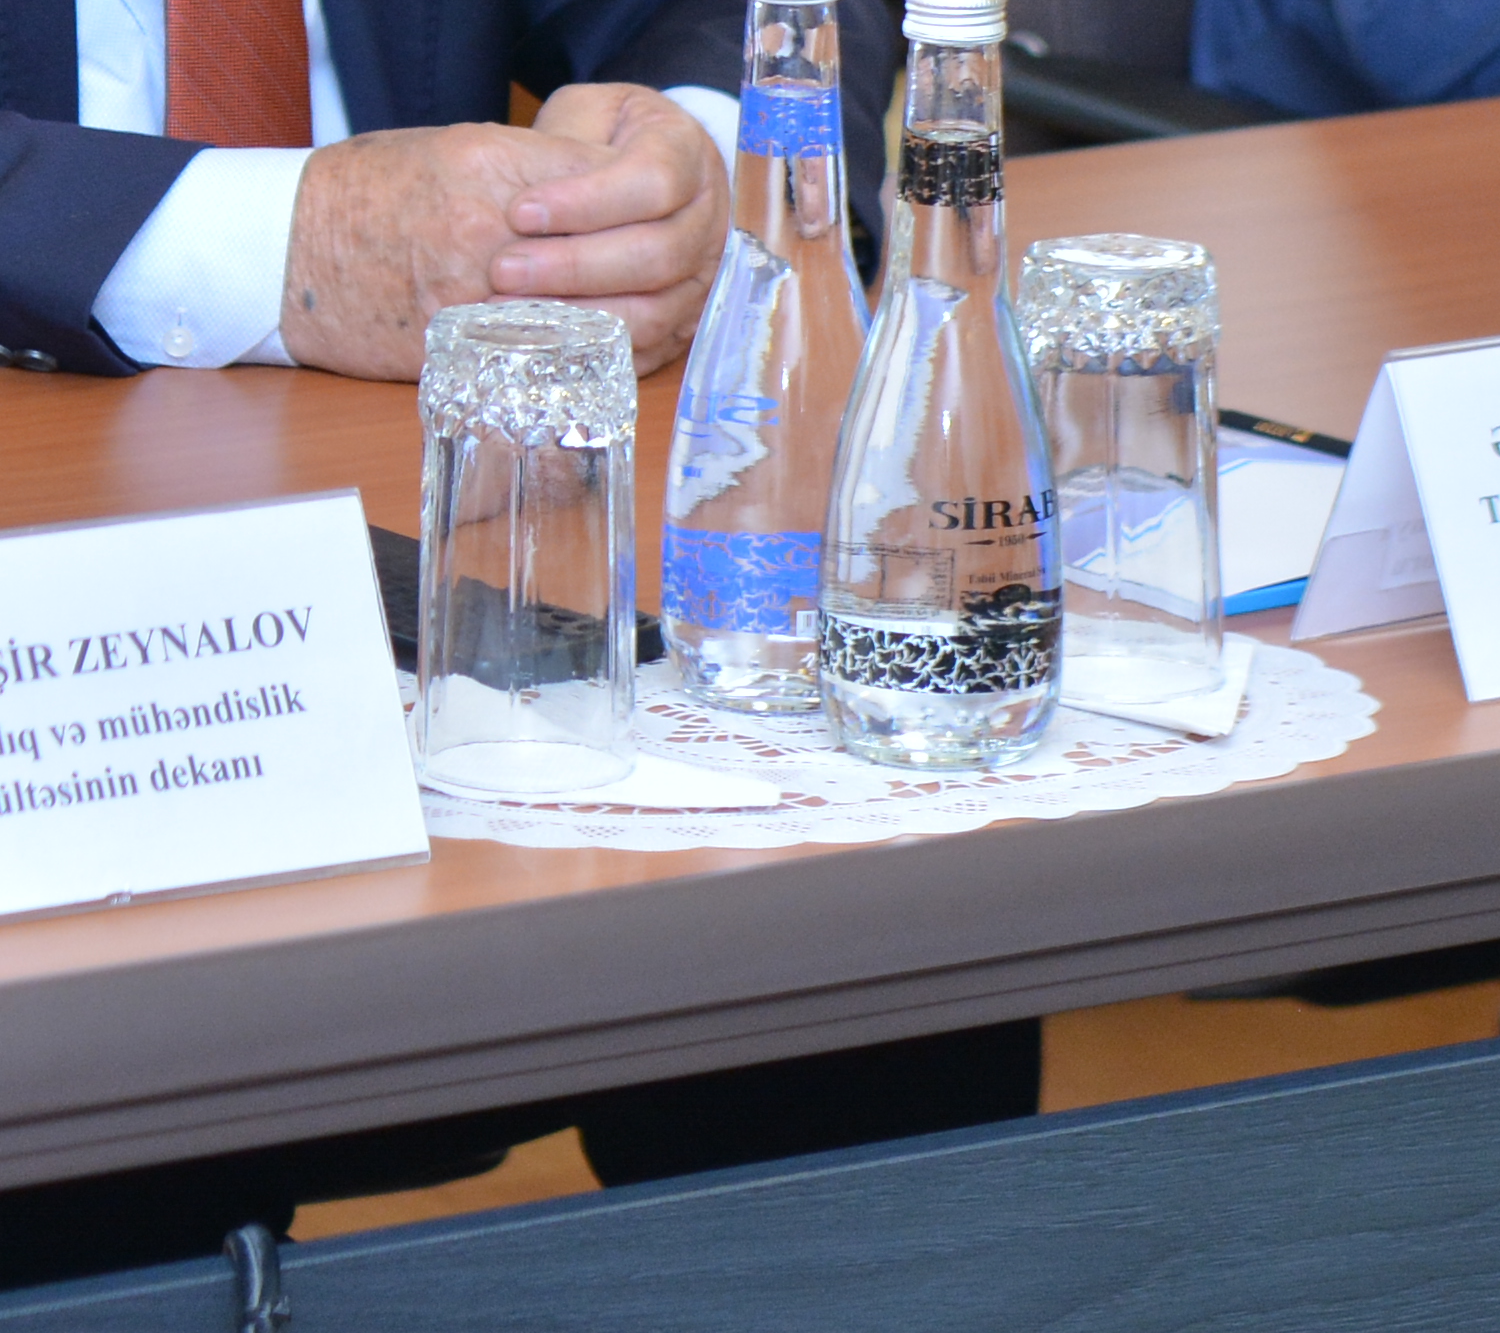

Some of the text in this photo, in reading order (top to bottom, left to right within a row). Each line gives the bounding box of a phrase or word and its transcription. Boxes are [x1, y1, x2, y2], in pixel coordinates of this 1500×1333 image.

[67, 605, 313, 675] ZEYNALOV
[49, 721, 86, 747] və
[97, 682, 307, 742] mühəndislik
[149, 753, 265, 793] dekanı
